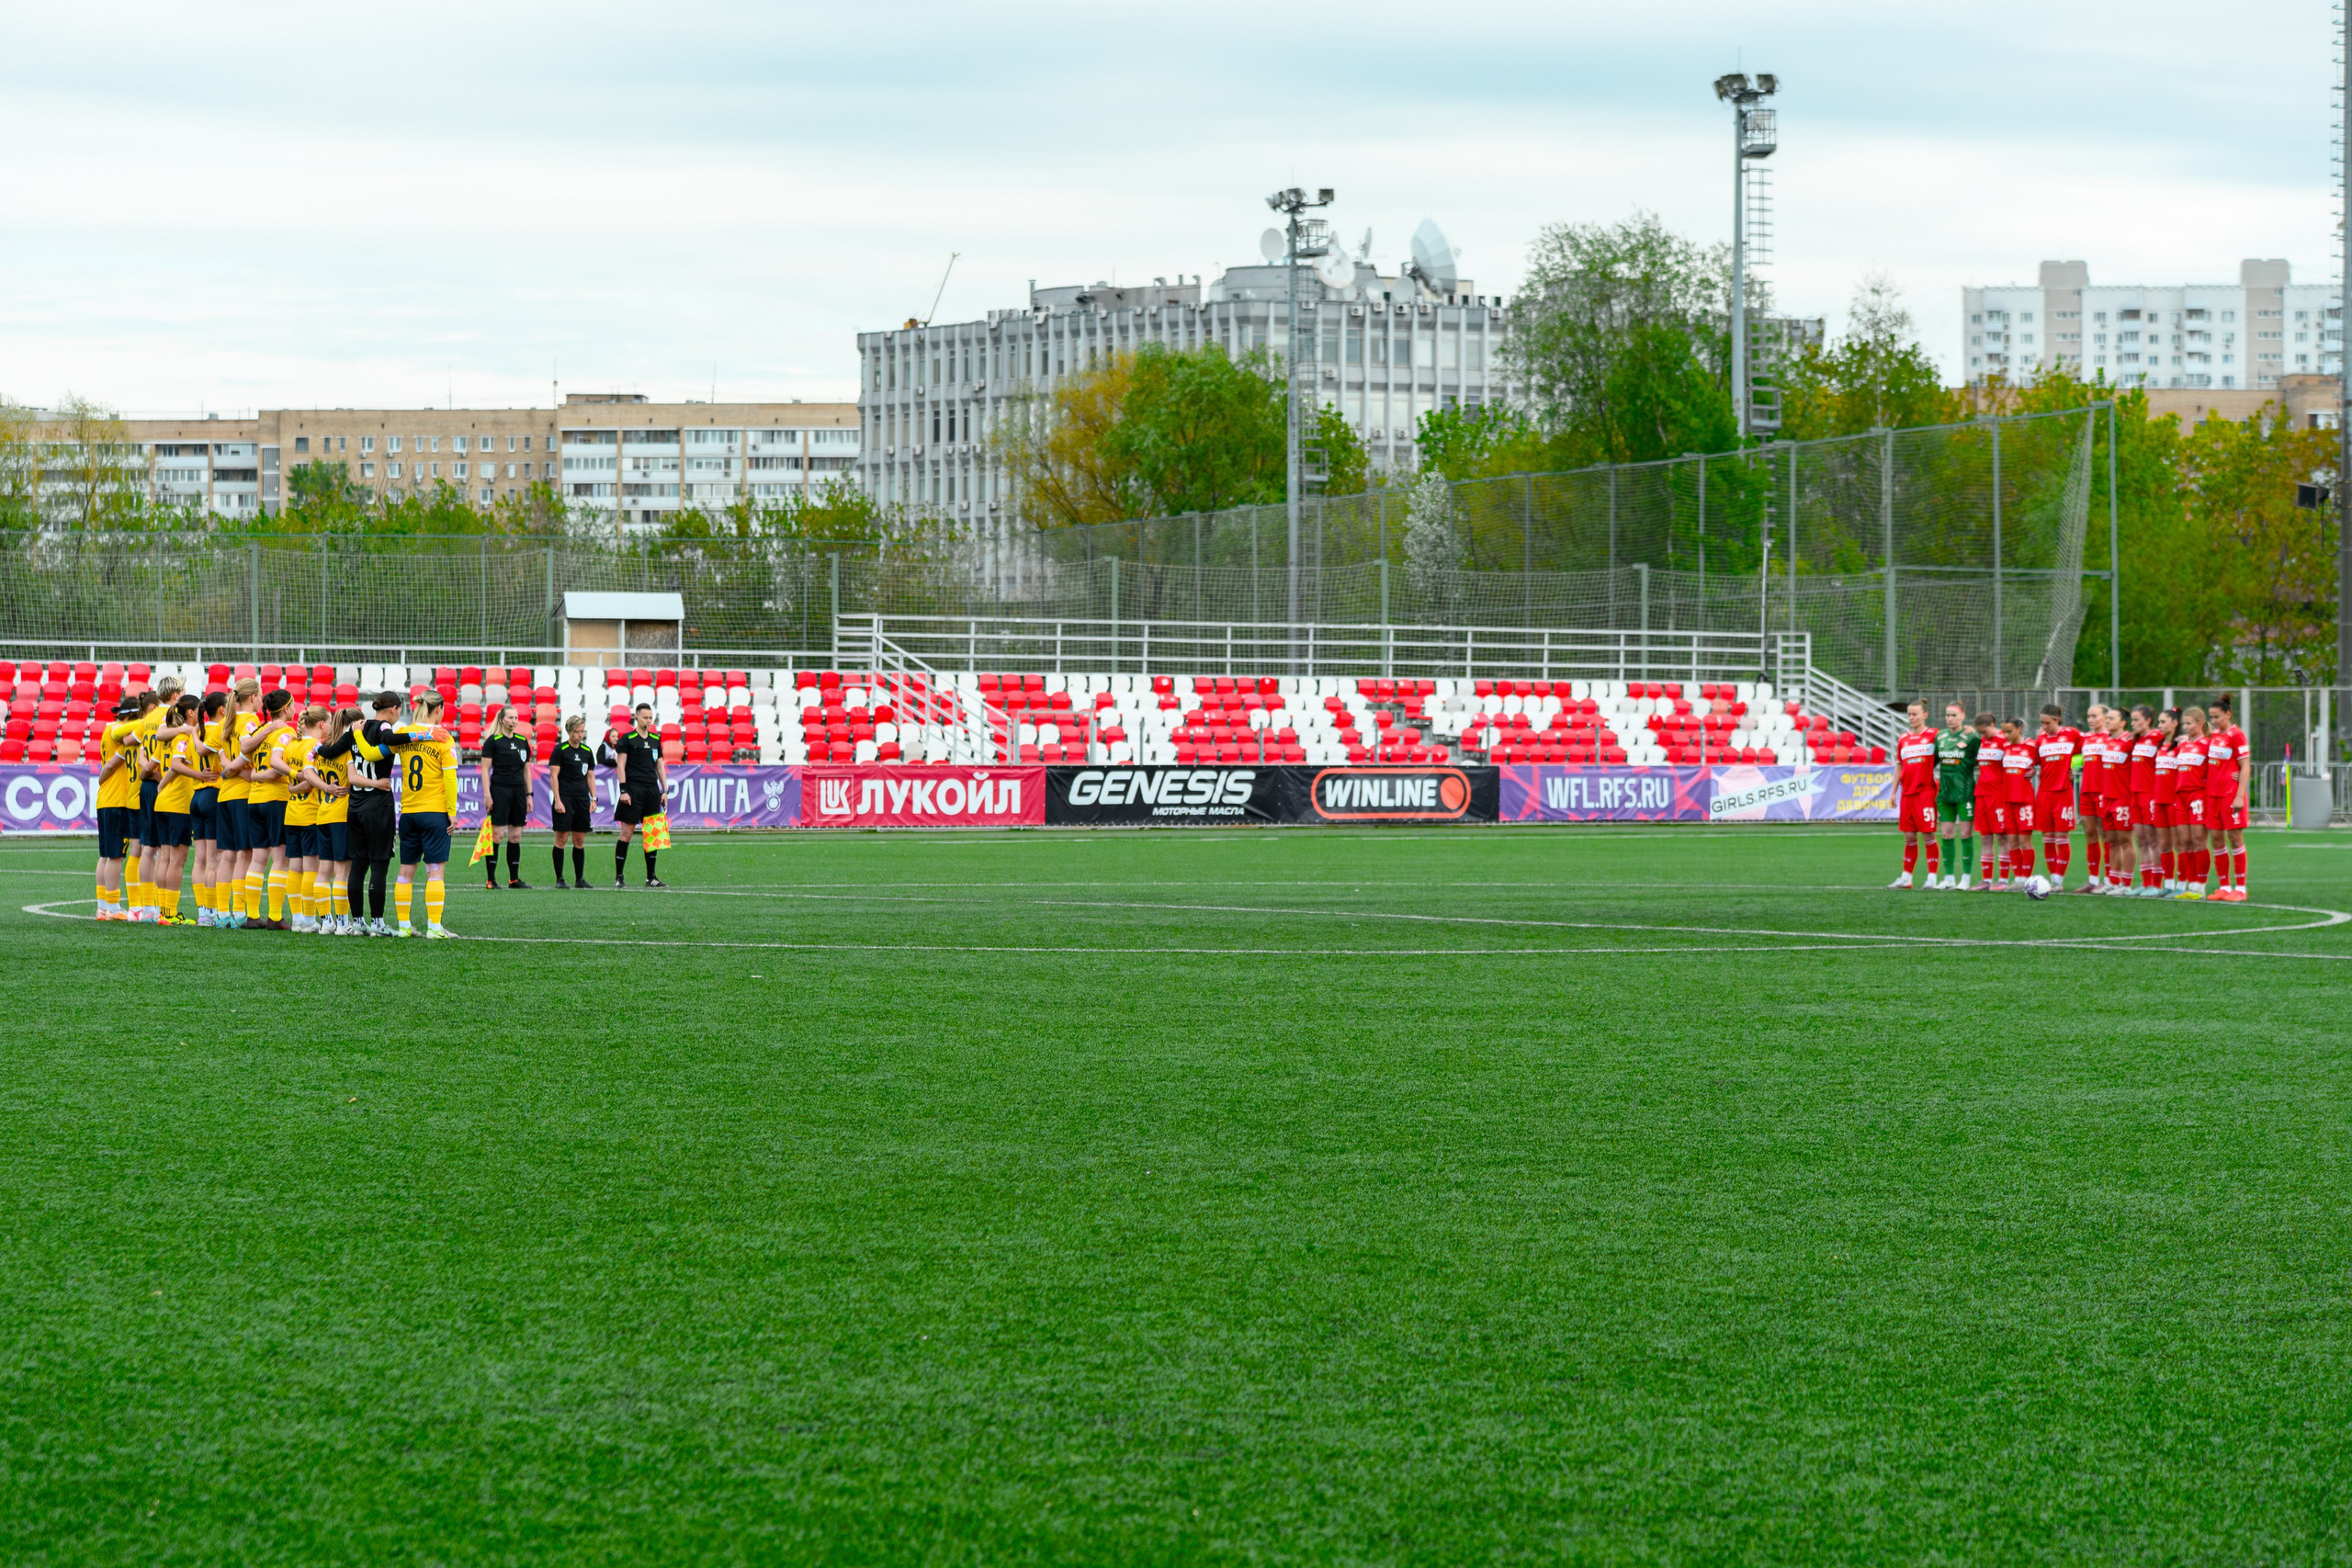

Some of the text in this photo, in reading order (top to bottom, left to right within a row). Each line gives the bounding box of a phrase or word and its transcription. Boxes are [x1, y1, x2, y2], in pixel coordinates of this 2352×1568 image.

[408, 755, 424, 792] 8
[1840, 773, 1893, 784] ФУТБОЛ
[857, 772, 1021, 816] ЛУКОЙЛ
[1069, 771, 1256, 806] GENESIS
[1326, 779, 1437, 807] WINLINE
[1546, 777, 1669, 808] WFL.RFS.RU
[1712, 779, 1807, 813] GIRLS.RFS.RU
[1853, 785, 1880, 797] ДЛЯ
[1152, 807, 1245, 816] МОТОРНЫЕ МАСЛА
[1923, 807, 1935, 822] 51
[2019, 806, 2034, 821] 93
[2061, 806, 2074, 820] 46
[2116, 807, 2131, 821] 23
[2189, 799, 2204, 815] 10
